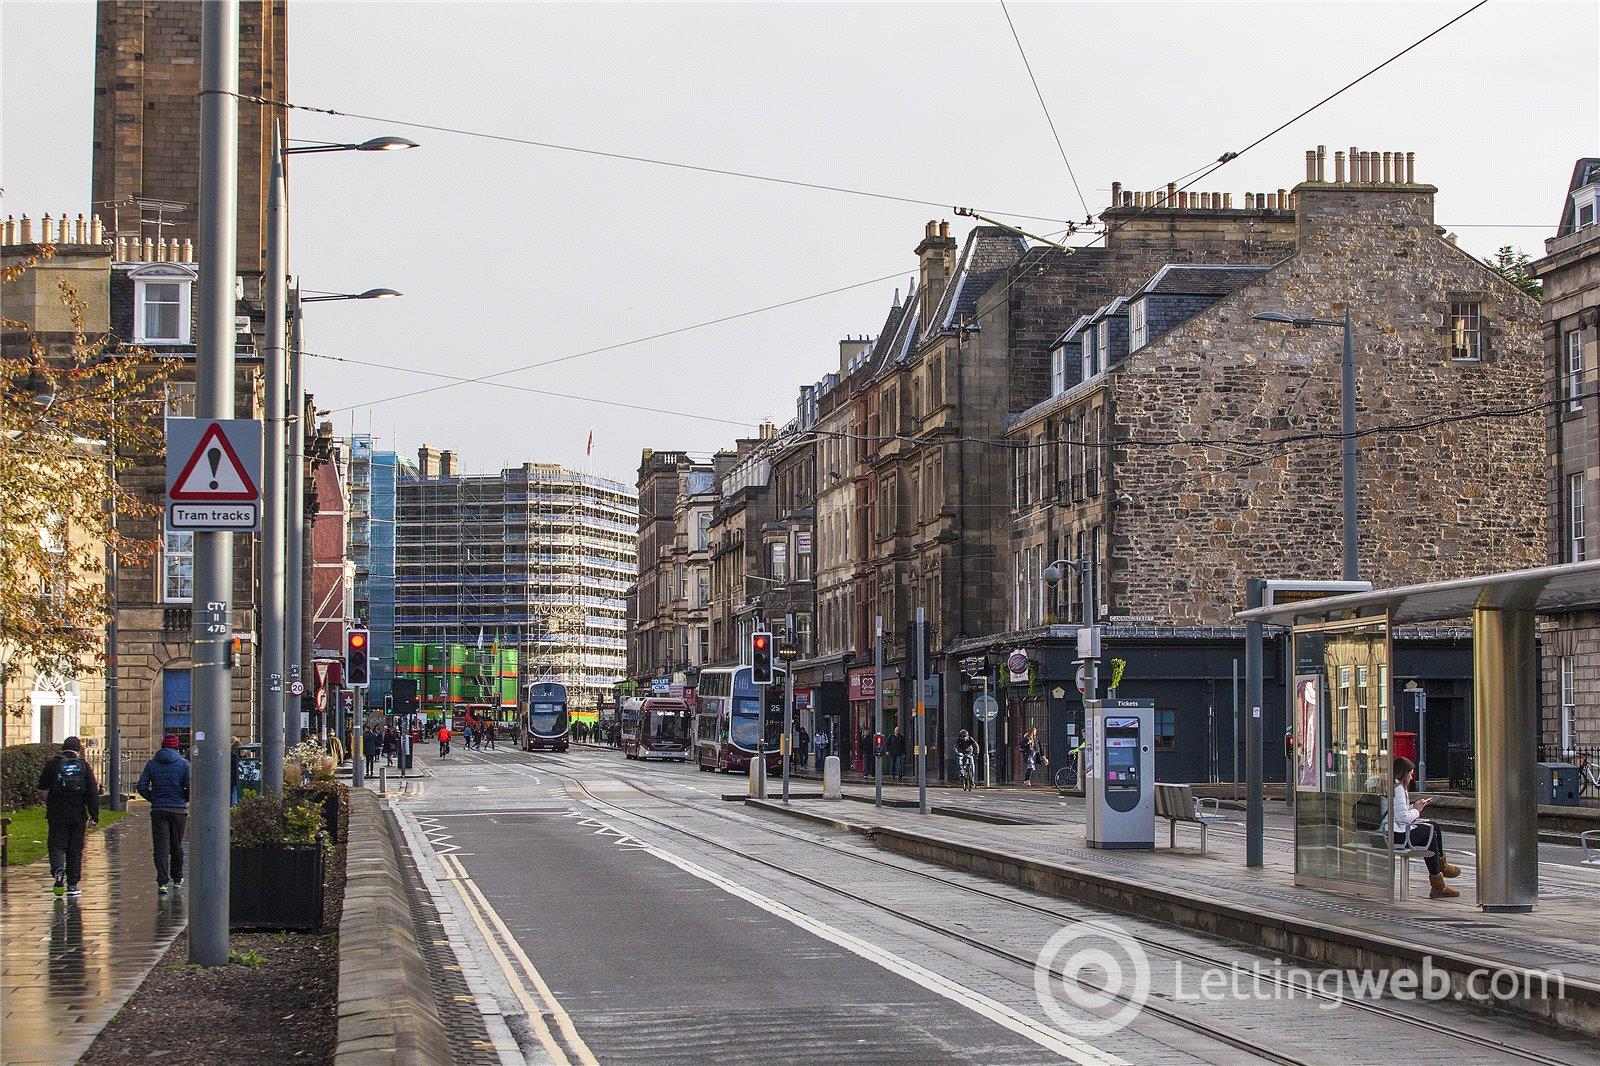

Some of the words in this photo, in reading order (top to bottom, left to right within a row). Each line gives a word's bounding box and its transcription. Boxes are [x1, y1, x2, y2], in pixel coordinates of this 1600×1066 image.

[177, 510, 208, 520] Tram
[212, 510, 250, 520] tracks
[208, 602, 226, 610] CTY
[207, 624, 226, 633] 47B
[292, 684, 303, 692] 20
[771, 704, 780, 712] 25
